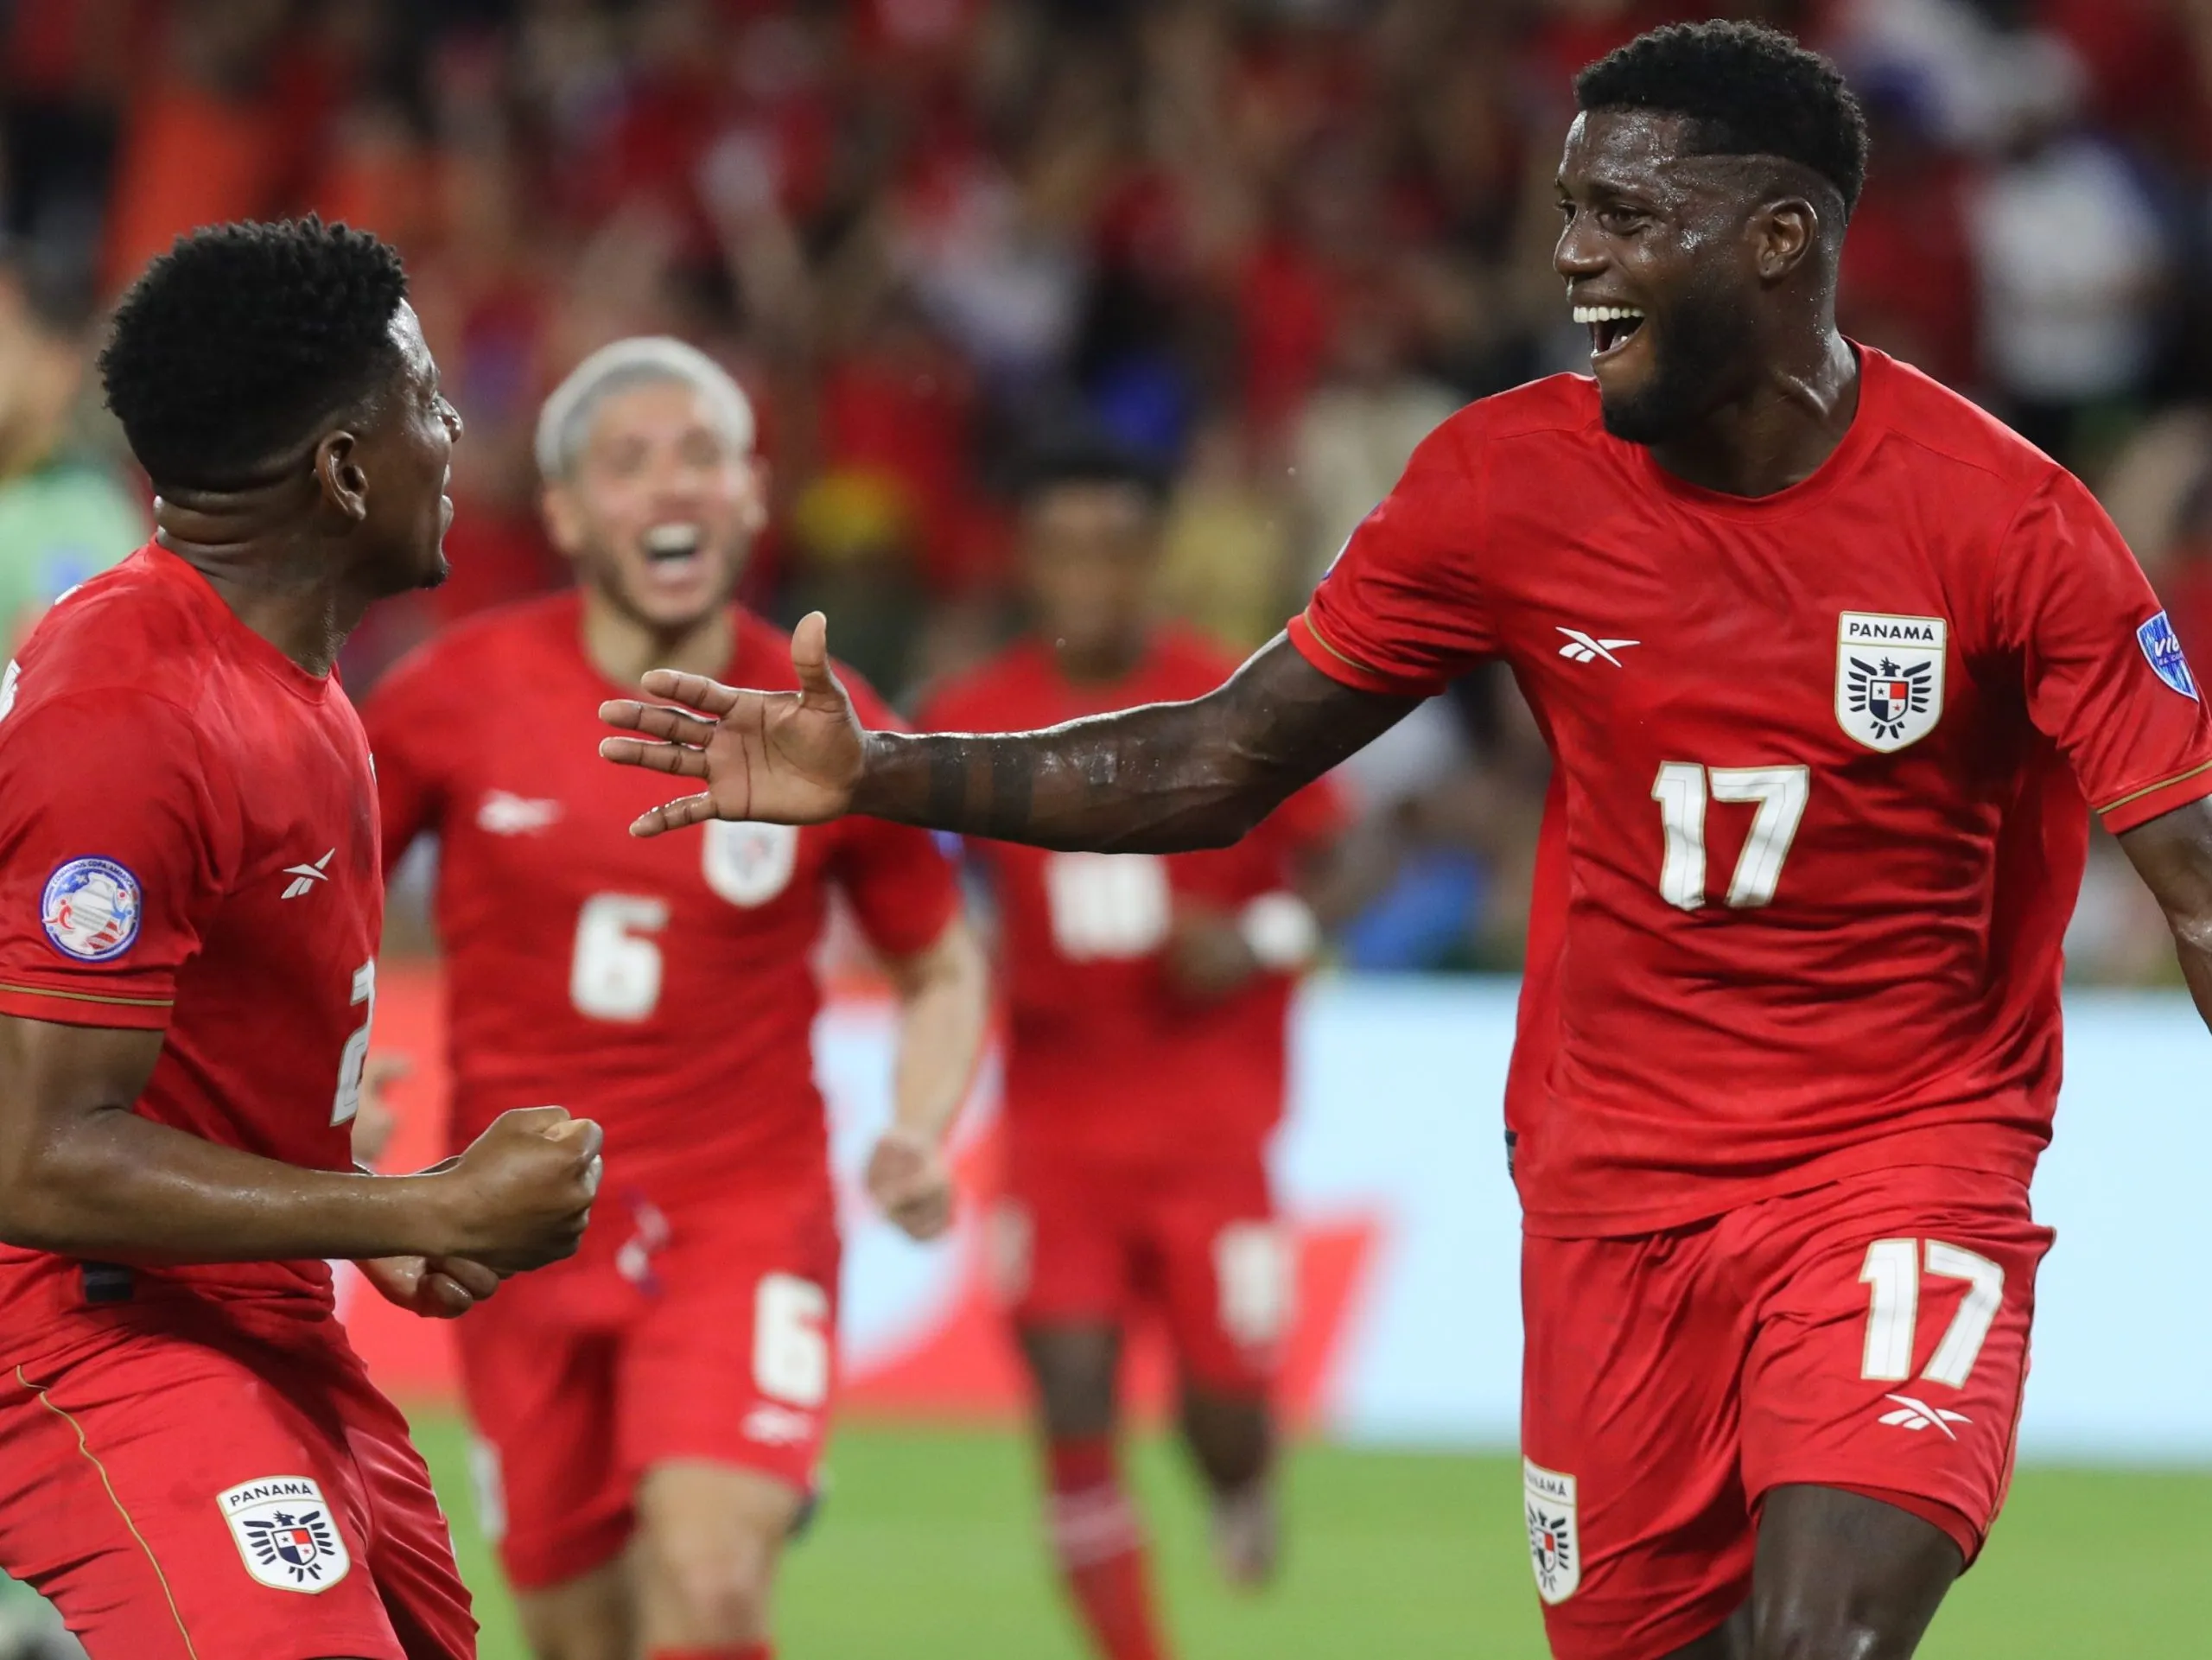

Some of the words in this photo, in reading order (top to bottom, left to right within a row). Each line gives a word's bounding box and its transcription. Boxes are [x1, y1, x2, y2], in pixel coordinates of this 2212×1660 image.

[1849, 622, 1934, 640] PANAMÁ
[1651, 760, 1809, 911] 17
[570, 892, 669, 1023] 6
[753, 1272, 829, 1409] 6
[1859, 1237, 2005, 1390] 17
